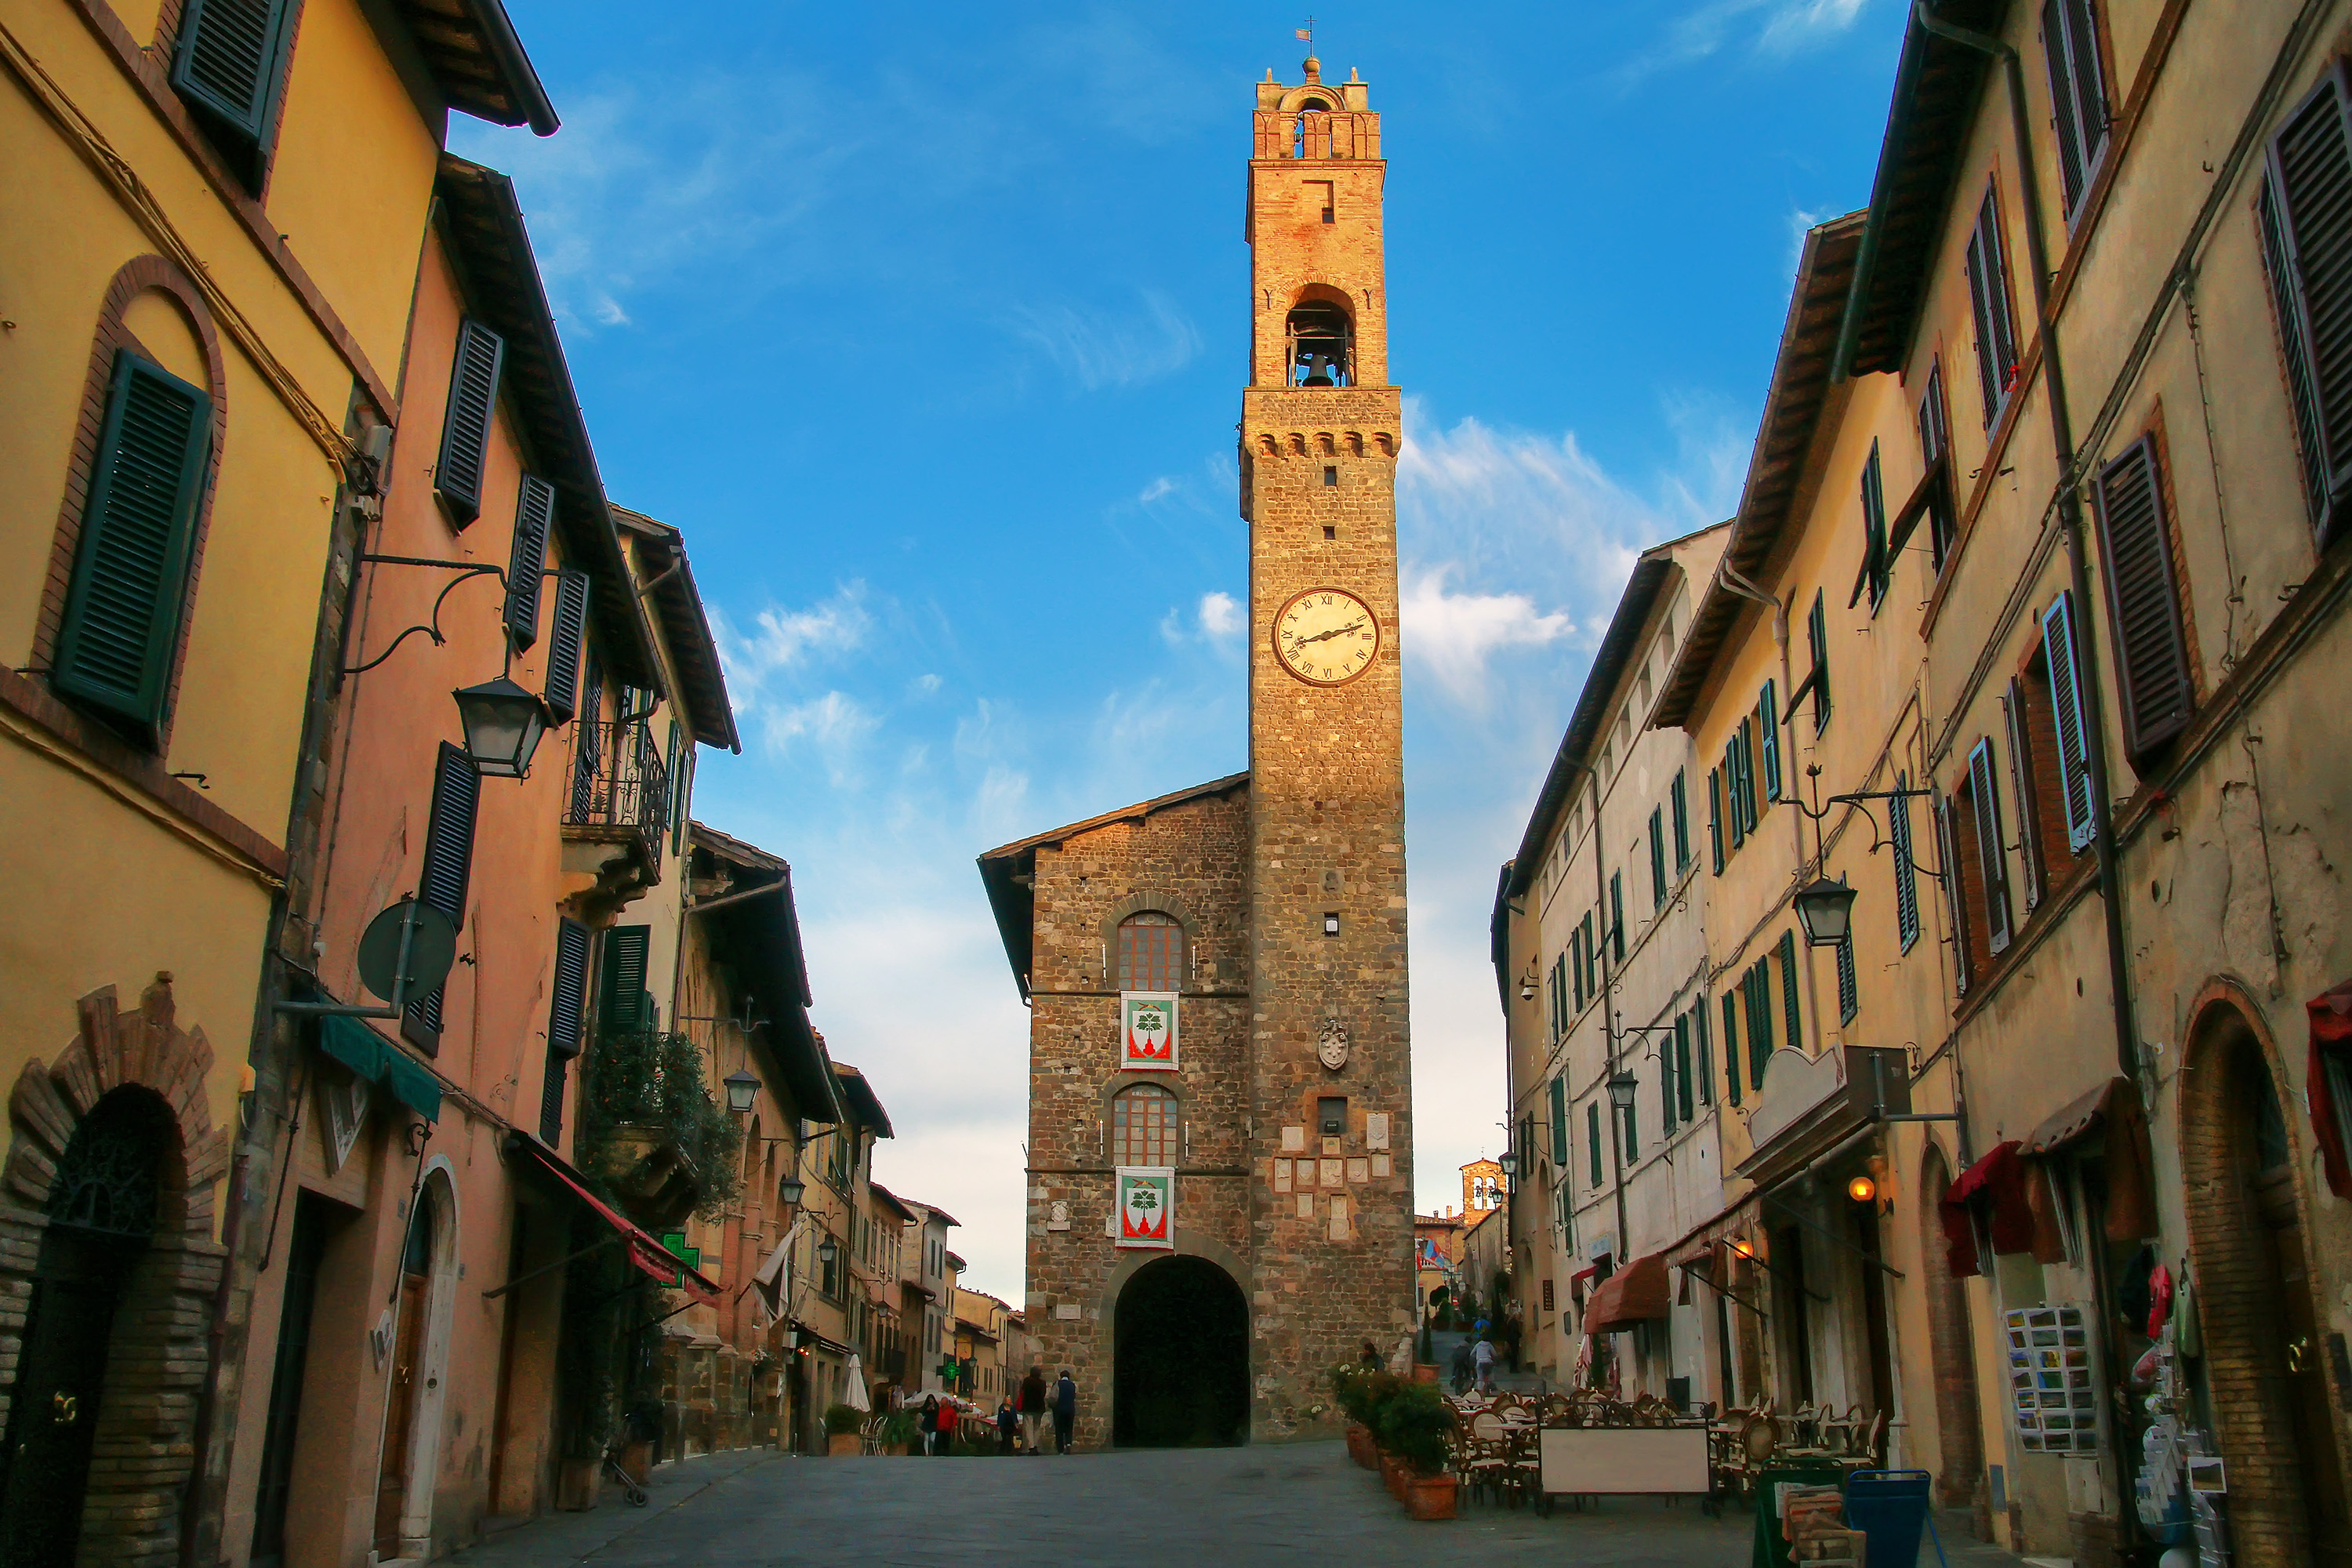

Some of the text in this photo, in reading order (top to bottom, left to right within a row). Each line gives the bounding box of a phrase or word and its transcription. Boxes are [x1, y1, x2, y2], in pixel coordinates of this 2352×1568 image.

[1302, 600, 1312, 610] XI
[1344, 600, 1351, 609] I
[1287, 613, 1298, 622] X
[1302, 662, 1314, 673] VII
[1343, 663, 1351, 673] V
[1323, 669, 1331, 677] VI
